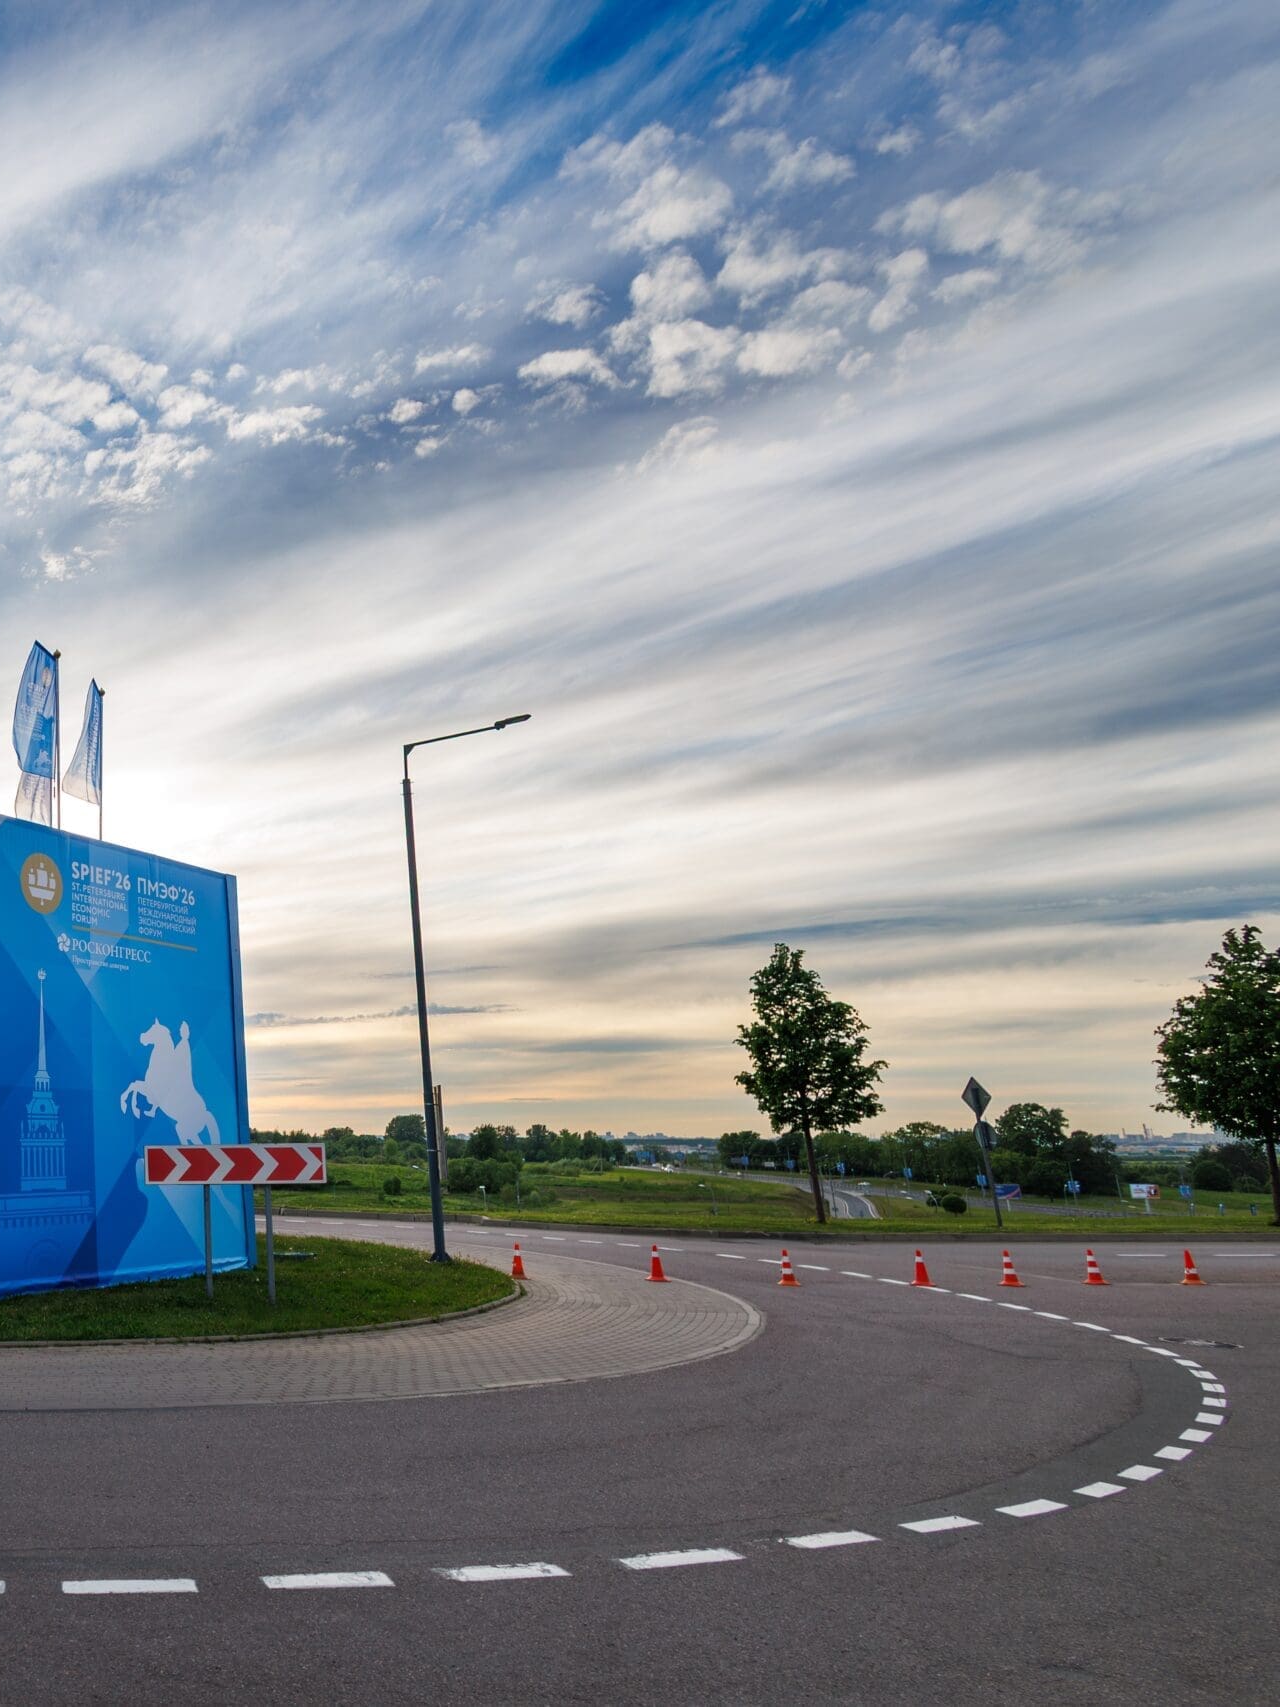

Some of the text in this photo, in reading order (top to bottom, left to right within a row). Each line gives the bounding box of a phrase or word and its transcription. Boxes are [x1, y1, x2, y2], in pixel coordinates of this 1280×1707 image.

[71, 892, 129, 912] INTERNATIONAL
[71, 902, 111, 920] ECONOMIC
[71, 912, 98, 927] FORUM
[138, 926, 163, 939] ФОРУМ
[72, 938, 152, 964] РОСКОНГРЕСС
